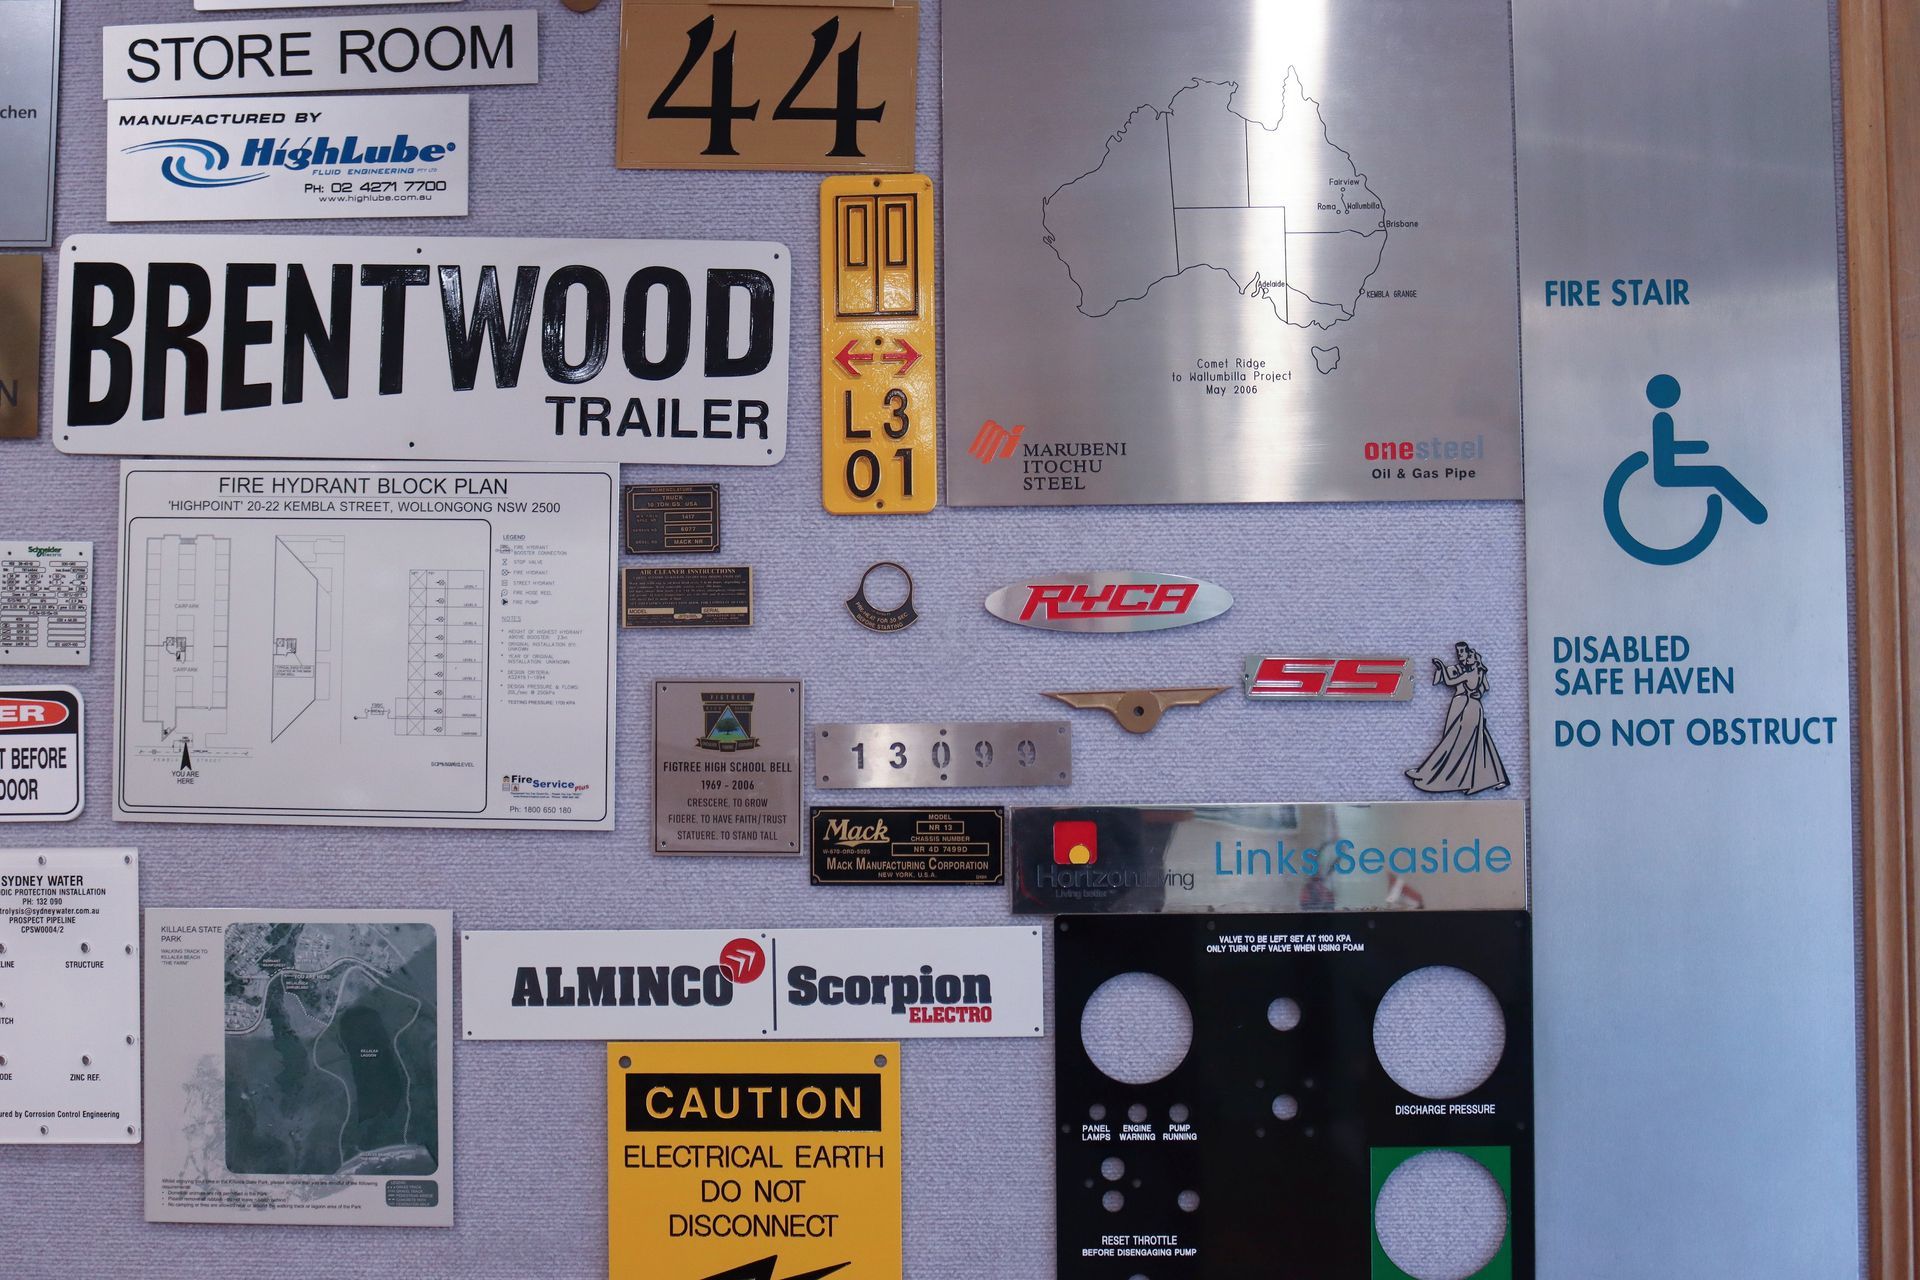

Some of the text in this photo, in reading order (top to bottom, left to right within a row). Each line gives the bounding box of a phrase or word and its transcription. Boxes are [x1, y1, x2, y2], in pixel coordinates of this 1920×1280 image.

[127, 24, 514, 84] STORE ROOM
[119, 112, 322, 126] MANUFACTURED BY
[241, 135, 447, 171] HighLube
[348, 168, 415, 176] ENGINEERING
[331, 182, 352, 193] 02
[360, 182, 397, 193] 4271
[404, 181, 447, 192] 7700
[1329, 178, 1360, 186] Fairview
[319, 194, 432, 204] www.highlube.com.au
[1317, 203, 1380, 211] Roma Wallumbilla
[1386, 220, 1419, 228] Brisbane
[1258, 280, 1285, 288] Adelaide
[1366, 290, 1417, 298] KEMBLA GRANGE
[1545, 278, 1690, 307] FIRE STAIR
[67, 261, 775, 428] BRENTWOOD
[1197, 358, 1266, 372] Comet Ridge
[1172, 370, 1292, 383] to Wallumbilla Project
[1206, 384, 1258, 397] May 2006
[545, 396, 770, 440] TRAILER
[1023, 442, 1127, 457] MARUBENI
[1364, 436, 1485, 461] onesteel
[1023, 459, 1103, 475] ITOCHU
[1371, 467, 1476, 481] Oil & Gas Pipe
[219, 477, 508, 495] FIRE HYDRANT BLOCK PLAN
[1023, 476, 1086, 491] STEEL
[168, 501, 560, 514] 'HIGHPOINT' 20-22 KEMBLA STREET, WOLLONGONG NSW 2500
[28, 546, 62, 557] Schneider
[1019, 584, 1201, 622] RYCA
[1553, 635, 1690, 664] DISABLED
[1555, 667, 1734, 696] SAFE HAVEN
[1555, 716, 1837, 747] DO NOT OBSTRUCT
[11, 747, 67, 769] BEFORE
[663, 762, 792, 773] FIGTREE HIGH SCHOOL BELL
[511, 775, 533, 783] Fire
[532, 780, 575, 788] Service
[701, 780, 722, 790] 1969
[732, 780, 755, 790] 2006
[733, 798, 743, 807] TO
[744, 798, 769, 807] GROW
[701, 815, 711, 824] TO
[712, 815, 733, 824] HAVE
[735, 815, 787, 825] FAITH/TRUST
[720, 831, 730, 840] TO
[733, 831, 758, 840] STAND
[760, 831, 778, 840] TALL
[822, 818, 891, 846] Mack
[1216, 838, 1513, 875] Links Seaside
[1, 875, 84, 887] SYDNEY WATER
[59, 888, 106, 896] INSTALLATION
[9, 916, 76, 924] PROSPECT PIPELINE
[21, 926, 64, 934] CPSW0004/2
[1257, 935, 1268, 943] BE
[1270, 935, 1288, 943] LEFT
[1318, 934, 1334, 942] 1100
[1336, 934, 1351, 942] KPA
[1207, 945, 1226, 953] ONLY
[1318, 944, 1341, 952] USING
[511, 964, 993, 1015] ALMINCO Scorpion
[909, 1006, 993, 1024] ELECTRO
[645, 1086, 863, 1120] CAUTION
[1395, 1104, 1496, 1115] DISCHARGE PRESSURE
[14, 1110, 22, 1120] by
[24, 1110, 56, 1118] Corrosion
[57, 1110, 81, 1118] Control
[82, 1111, 120, 1120] Engineering
[1123, 1124, 1152, 1132] ENGINE
[1169, 1124, 1191, 1132] PUMP
[1082, 1133, 1111, 1141] LAMPS
[1119, 1133, 1156, 1141] WARNING
[1163, 1133, 1198, 1141] RUNNING
[624, 1144, 884, 1169] ELECTRICAL EARTH
[701, 1179, 806, 1203] DO NOT
[669, 1213, 839, 1238] DISCONNECT
[1102, 1235, 1178, 1246] RESET THROTTLE
[1082, 1248, 1197, 1257] BEFORE DISENGAGING PUMP
